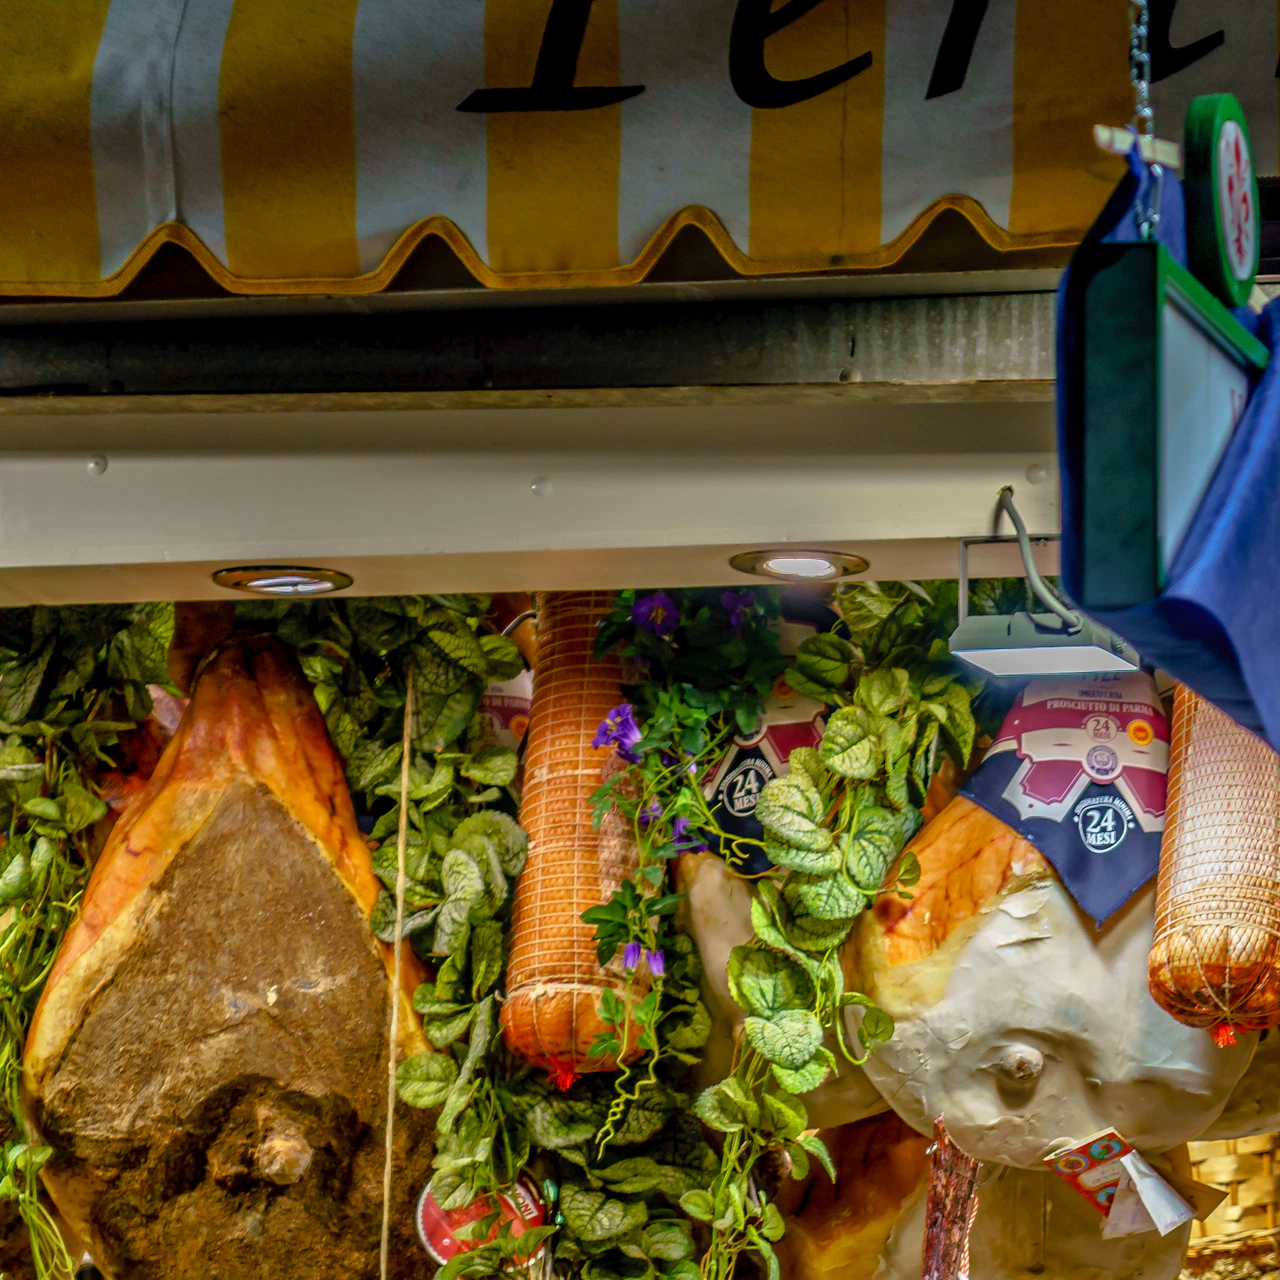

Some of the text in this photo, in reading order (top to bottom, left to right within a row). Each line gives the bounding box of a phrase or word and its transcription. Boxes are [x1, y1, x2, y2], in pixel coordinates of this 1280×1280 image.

[1046, 700, 1154, 716] PROSCIUTTO DI PARMA
[1092, 718, 1110, 731] 24
[732, 769, 760, 799] 24
[1085, 809, 1116, 833] 24
[1085, 832, 1116, 845] MESI
